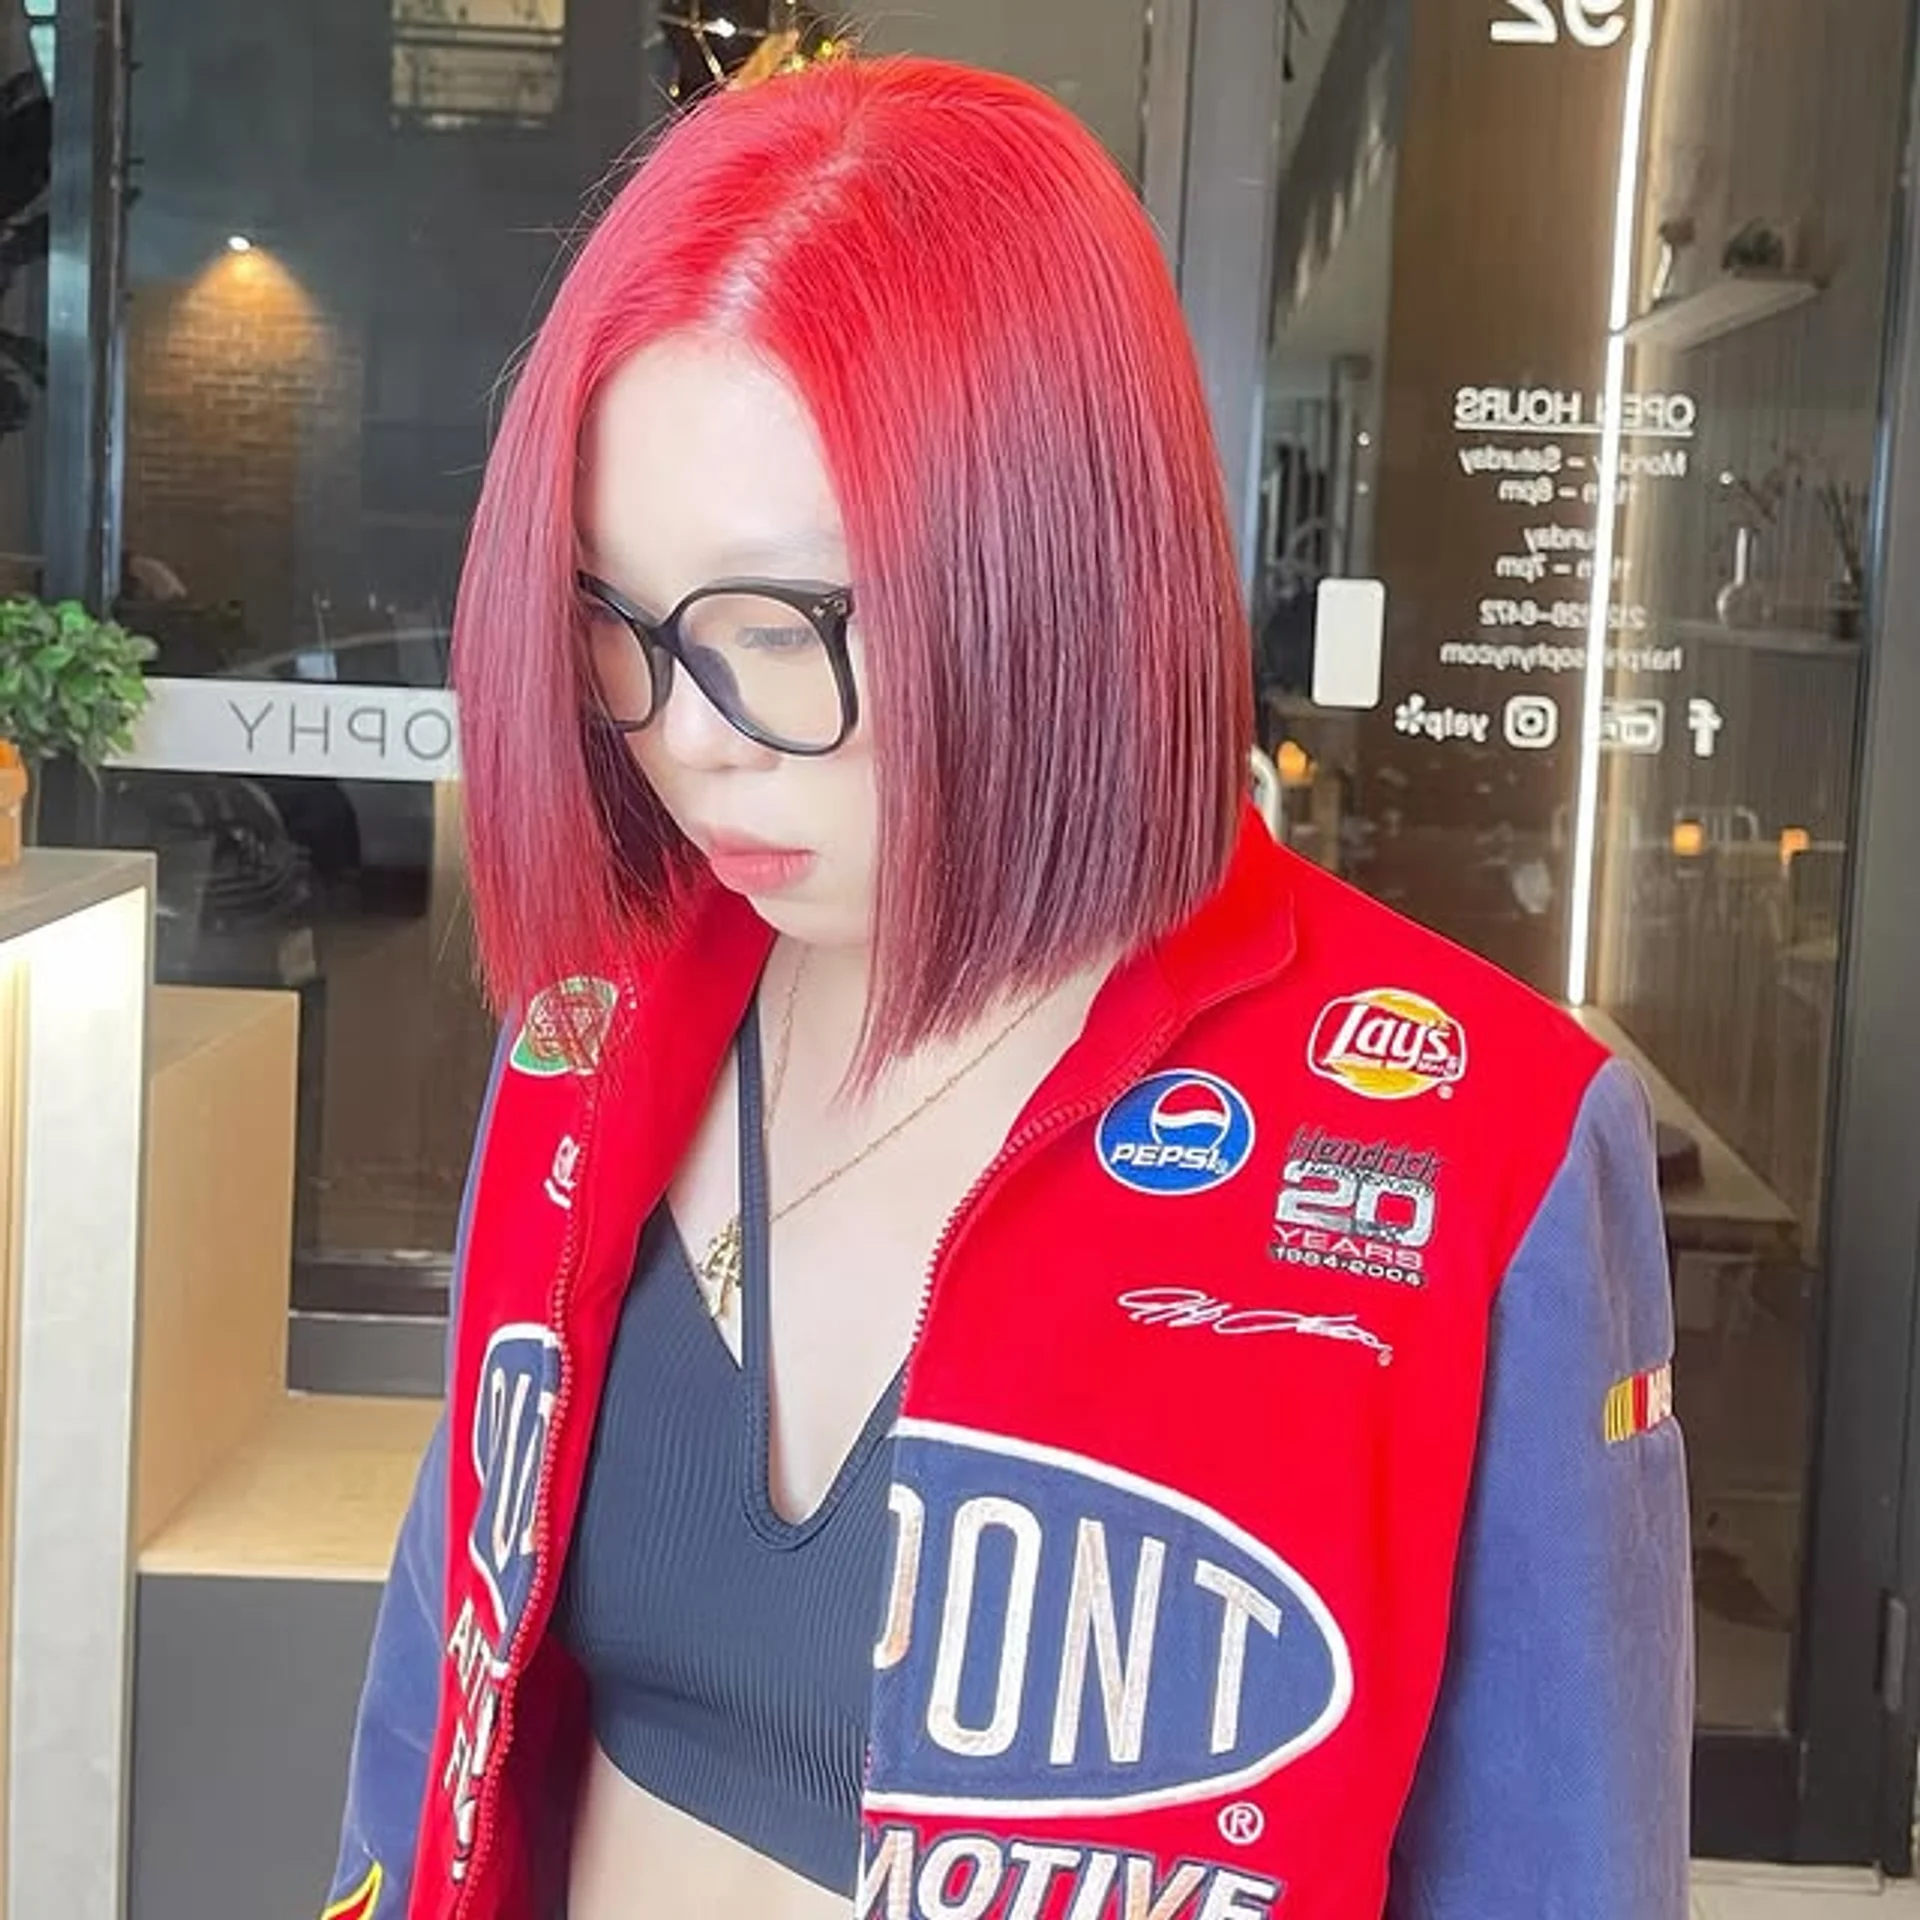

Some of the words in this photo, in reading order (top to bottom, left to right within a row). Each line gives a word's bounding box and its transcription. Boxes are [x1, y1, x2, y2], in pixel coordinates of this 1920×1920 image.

[1110, 1142, 1221, 1172] PEPSI
[1288, 1122, 1446, 1184] Hendrick
[1274, 1160, 1437, 1248] 20
[1271, 1224, 1424, 1270] YEARS
